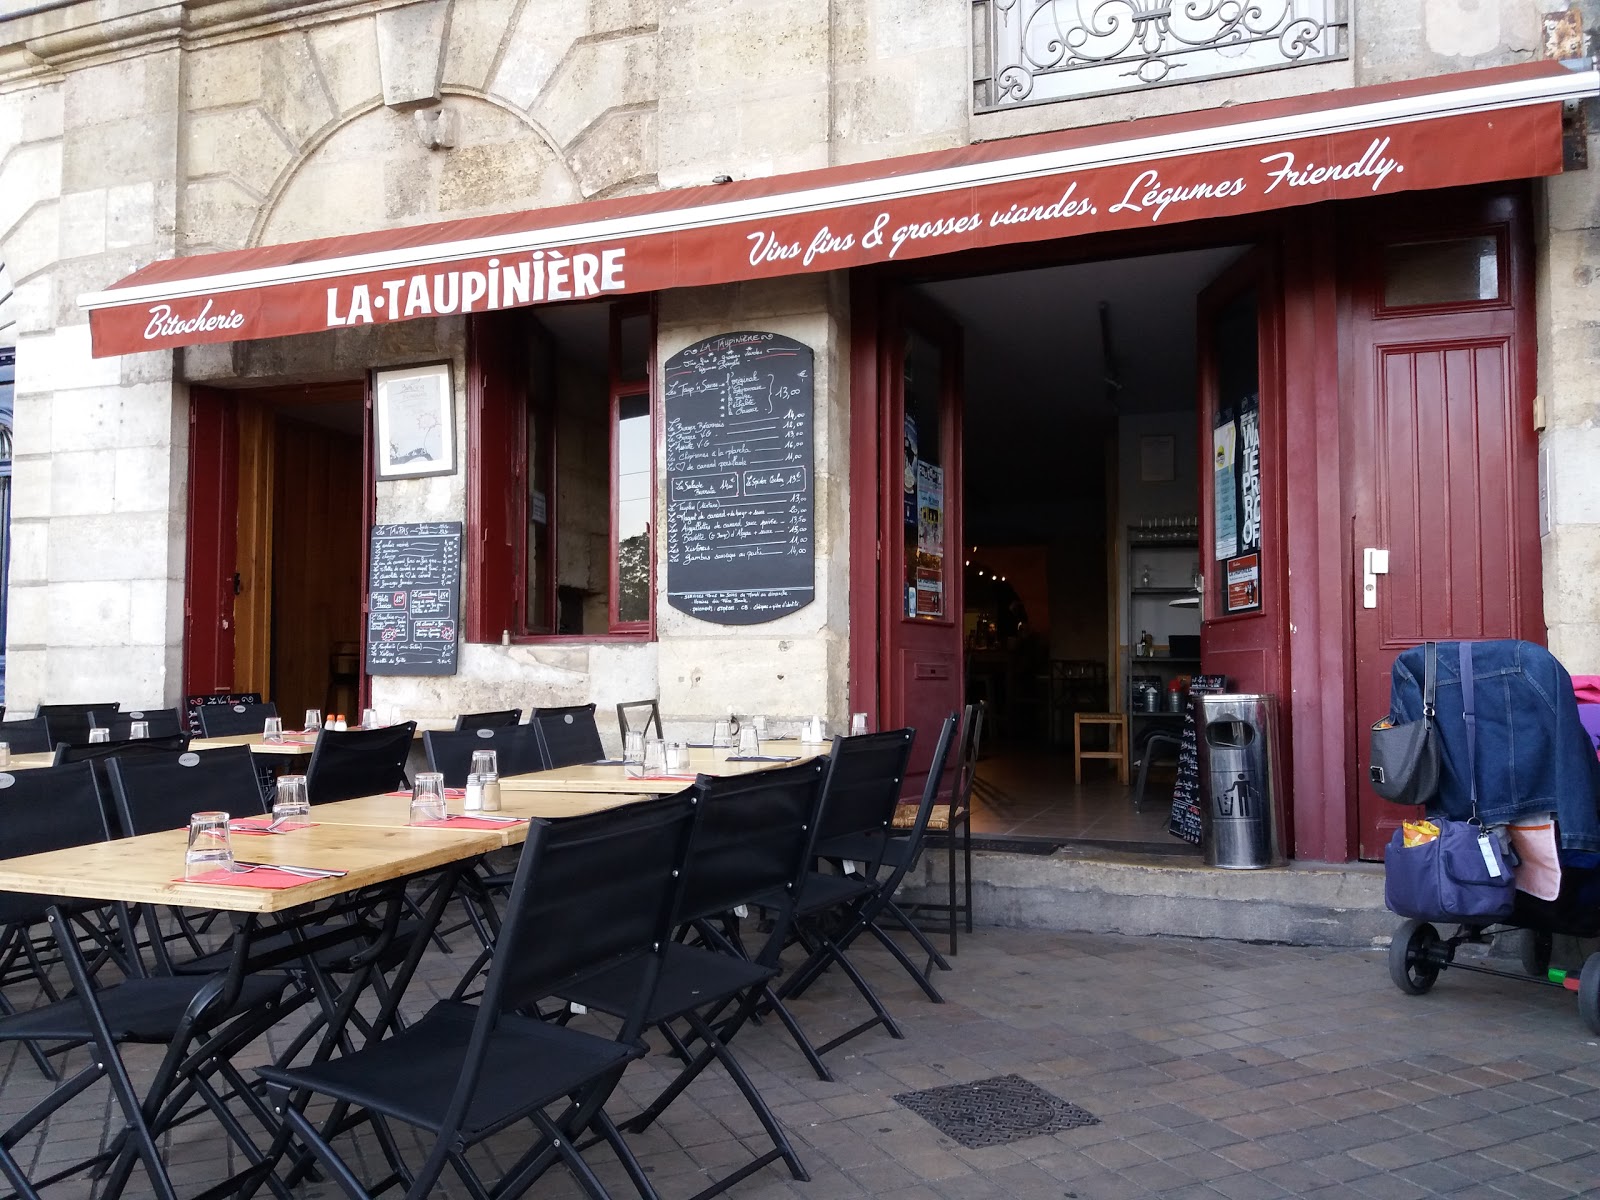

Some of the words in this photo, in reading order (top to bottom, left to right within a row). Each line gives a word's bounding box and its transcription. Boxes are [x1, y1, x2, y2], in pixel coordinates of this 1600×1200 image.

[746, 230, 802, 267] Vins
[803, 221, 855, 267] fins
[861, 212, 891, 248] &
[889, 211, 982, 258] grosses
[989, 181, 1098, 231] viandes.
[1108, 169, 1246, 224] Légumes
[1258, 135, 1405, 194] Friendly.
[143, 299, 245, 341] Bitocherie
[775, 386, 801, 400] 13,00
[783, 408, 805, 421] 14,00
[784, 430, 804, 439] 13,00
[784, 440, 804, 450] 16,00
[687, 463, 695, 471] de
[696, 459, 717, 470] canard
[785, 452, 803, 463] 11,00
[790, 493, 807, 504] 13,00
[706, 509, 726, 520] canard
[714, 521, 721, 530] de
[723, 519, 743, 529] canard
[789, 536, 808, 546] 11,00
[787, 545, 807, 557] 14,00
